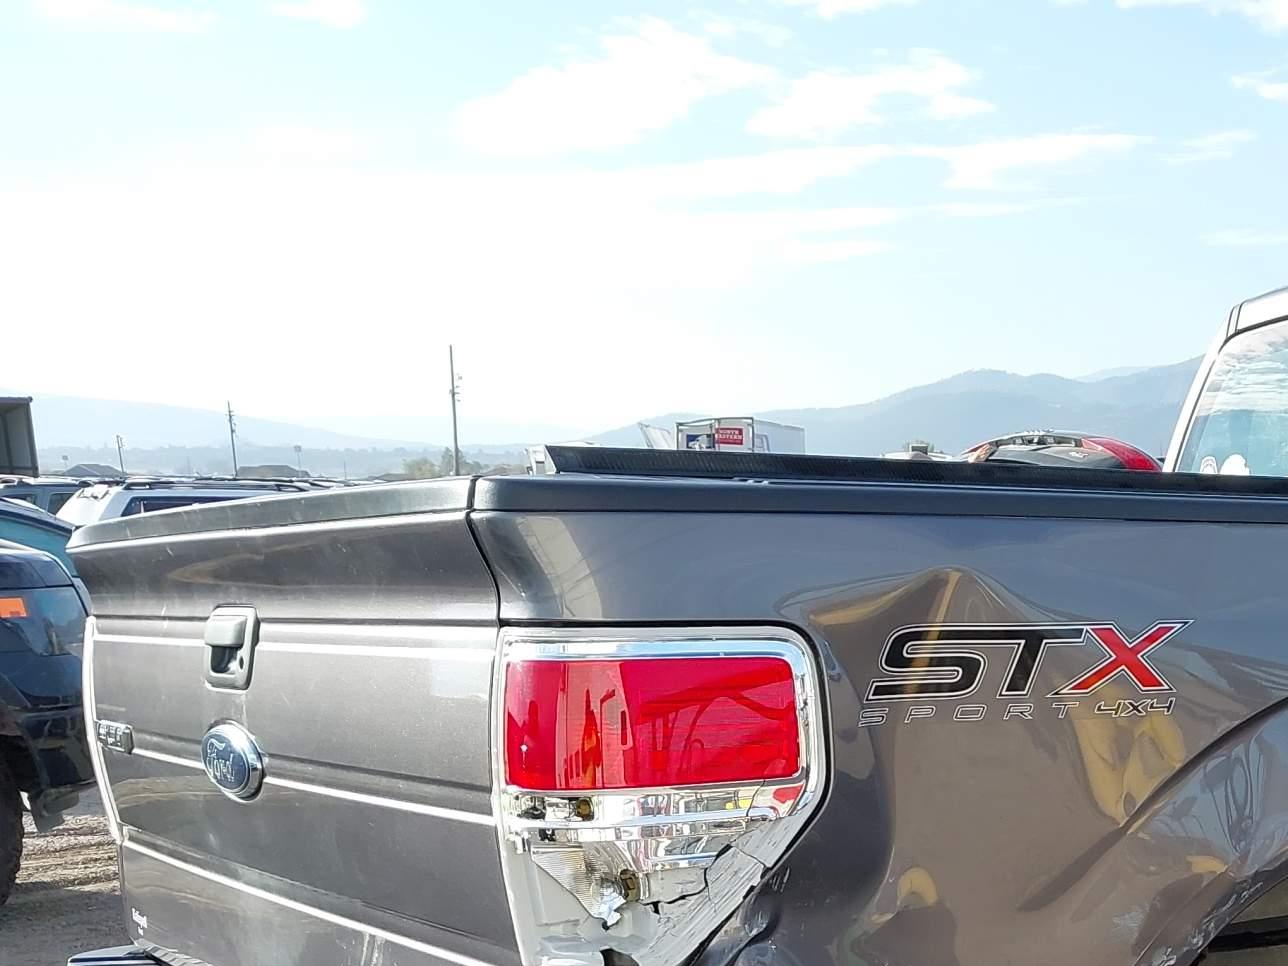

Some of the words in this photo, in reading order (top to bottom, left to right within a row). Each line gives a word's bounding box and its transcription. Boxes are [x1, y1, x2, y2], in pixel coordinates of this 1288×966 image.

[864, 619, 1195, 703] STX
[858, 702, 1079, 727] SPORT
[206, 738, 235, 783] Ford
